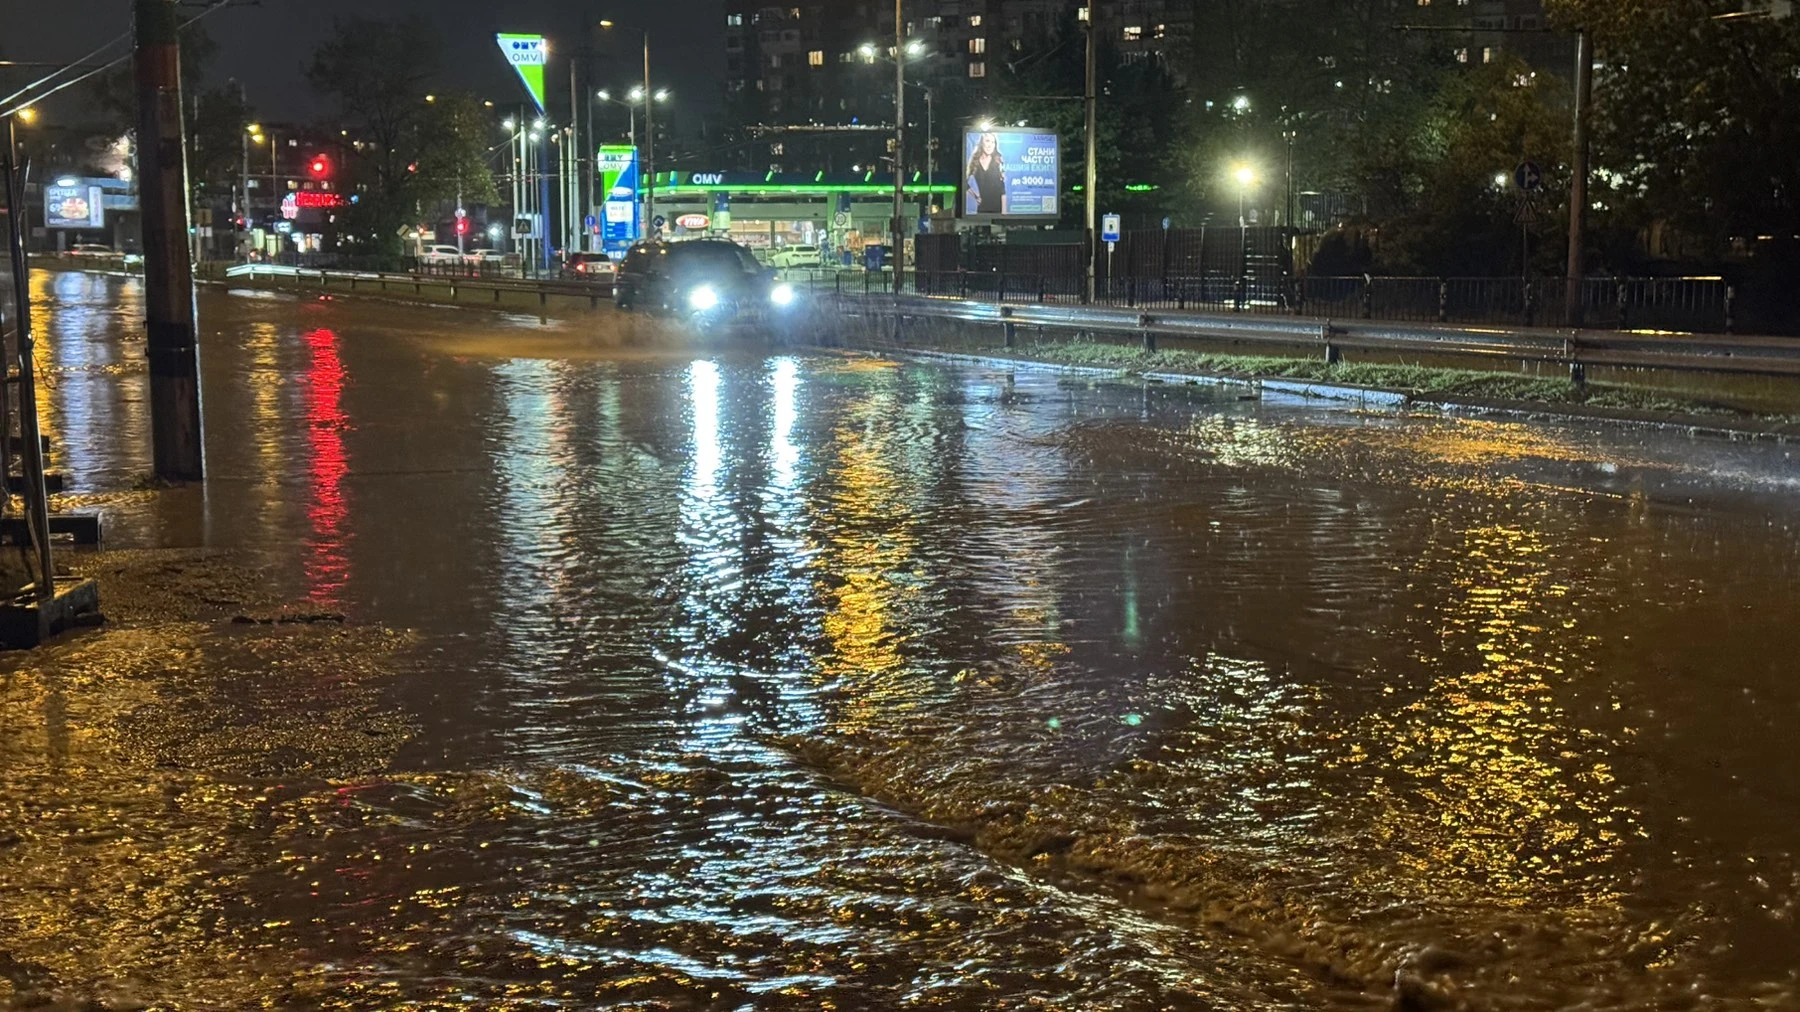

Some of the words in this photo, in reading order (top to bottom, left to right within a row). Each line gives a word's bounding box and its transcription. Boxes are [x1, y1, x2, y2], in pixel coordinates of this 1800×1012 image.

[512, 53, 538, 62] OMV
[1027, 147, 1055, 156] СТАНИ
[1021, 155, 1042, 164] ЧАСТ
[1043, 155, 1055, 164] ОТ
[692, 173, 722, 185] OMV
[1011, 177, 1021, 186] до
[1021, 175, 1044, 185] 3000
[684, 217, 706, 227] VIVA
